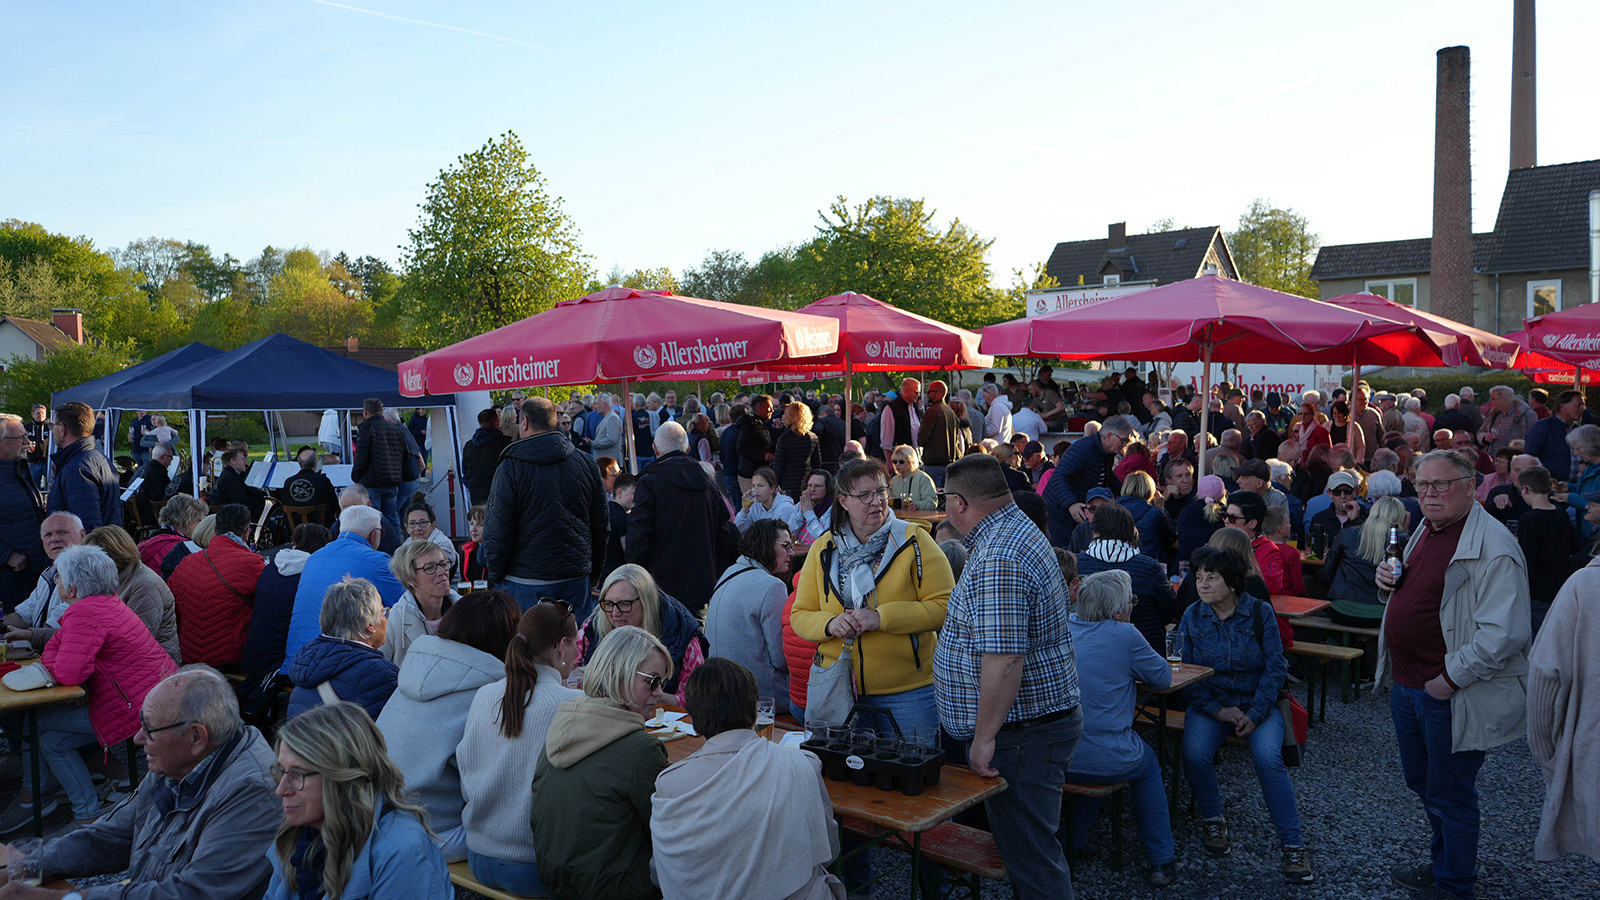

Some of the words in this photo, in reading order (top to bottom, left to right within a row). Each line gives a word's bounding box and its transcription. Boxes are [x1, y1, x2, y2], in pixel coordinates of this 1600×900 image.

[660, 337, 748, 367] Allersheimer
[882, 341, 942, 359] Allersheimer
[1556, 333, 1600, 351] Allershei
[477, 355, 560, 385] Allersheimer
